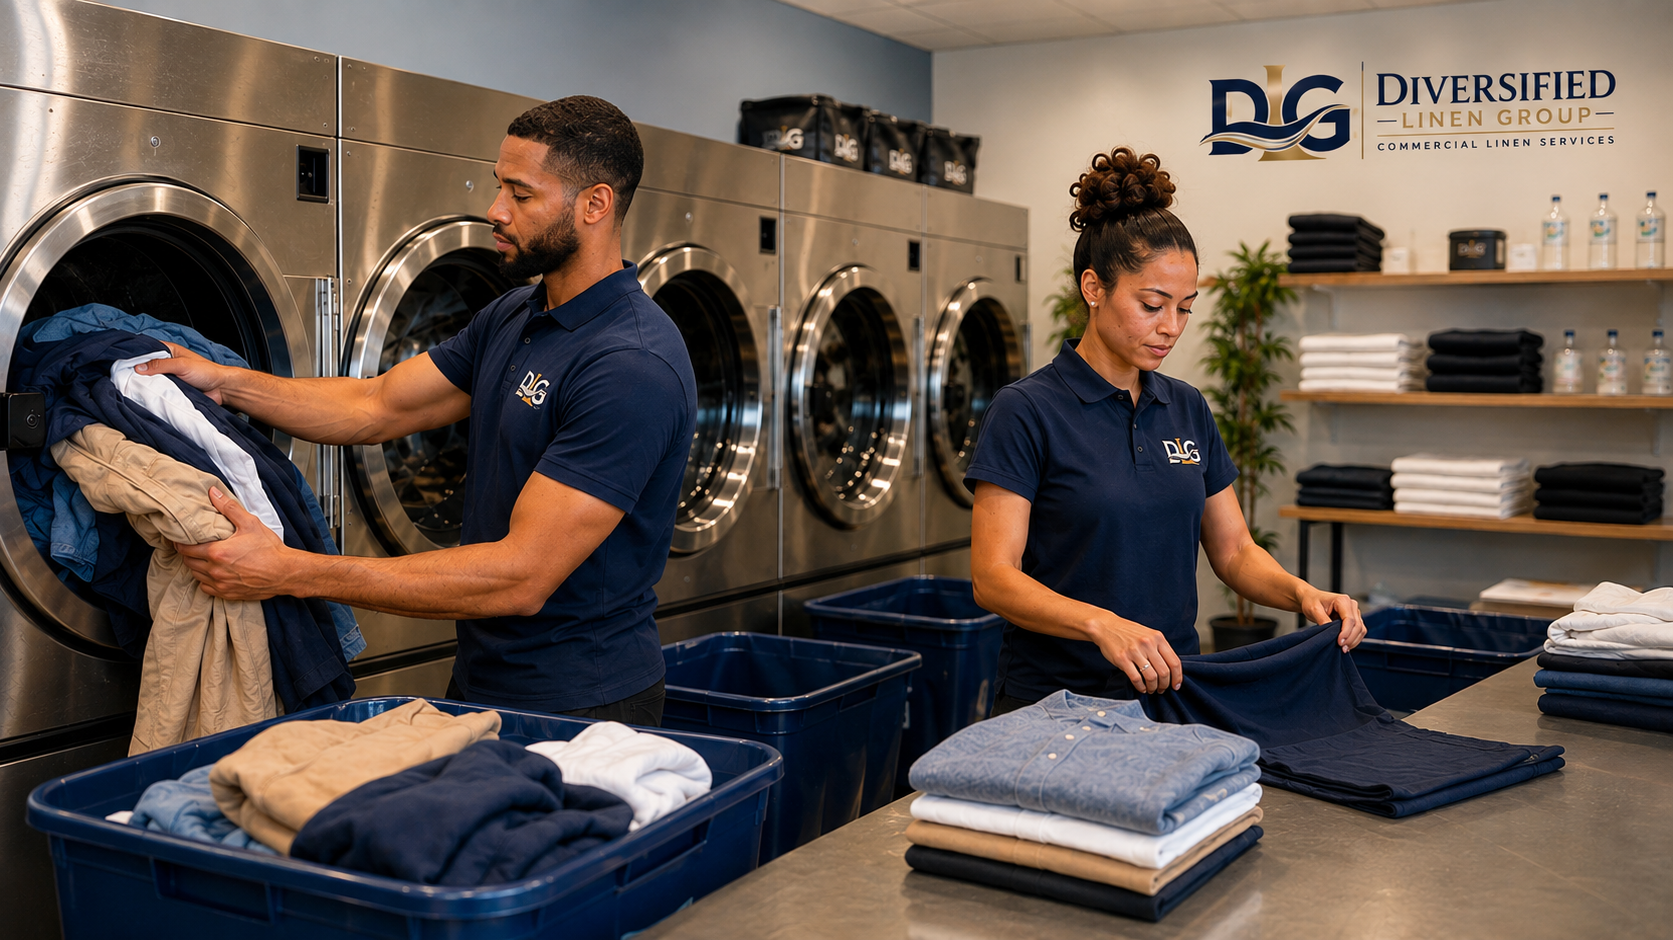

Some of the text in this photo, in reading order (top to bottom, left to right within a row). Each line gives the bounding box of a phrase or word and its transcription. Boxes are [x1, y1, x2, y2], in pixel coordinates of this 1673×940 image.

[1376, 69, 1616, 106] DIVERSIFIED
[1402, 107, 1591, 128] LINEN GROUP
[1377, 135, 1615, 151] COMMERCIAL LINEN SERVICES
